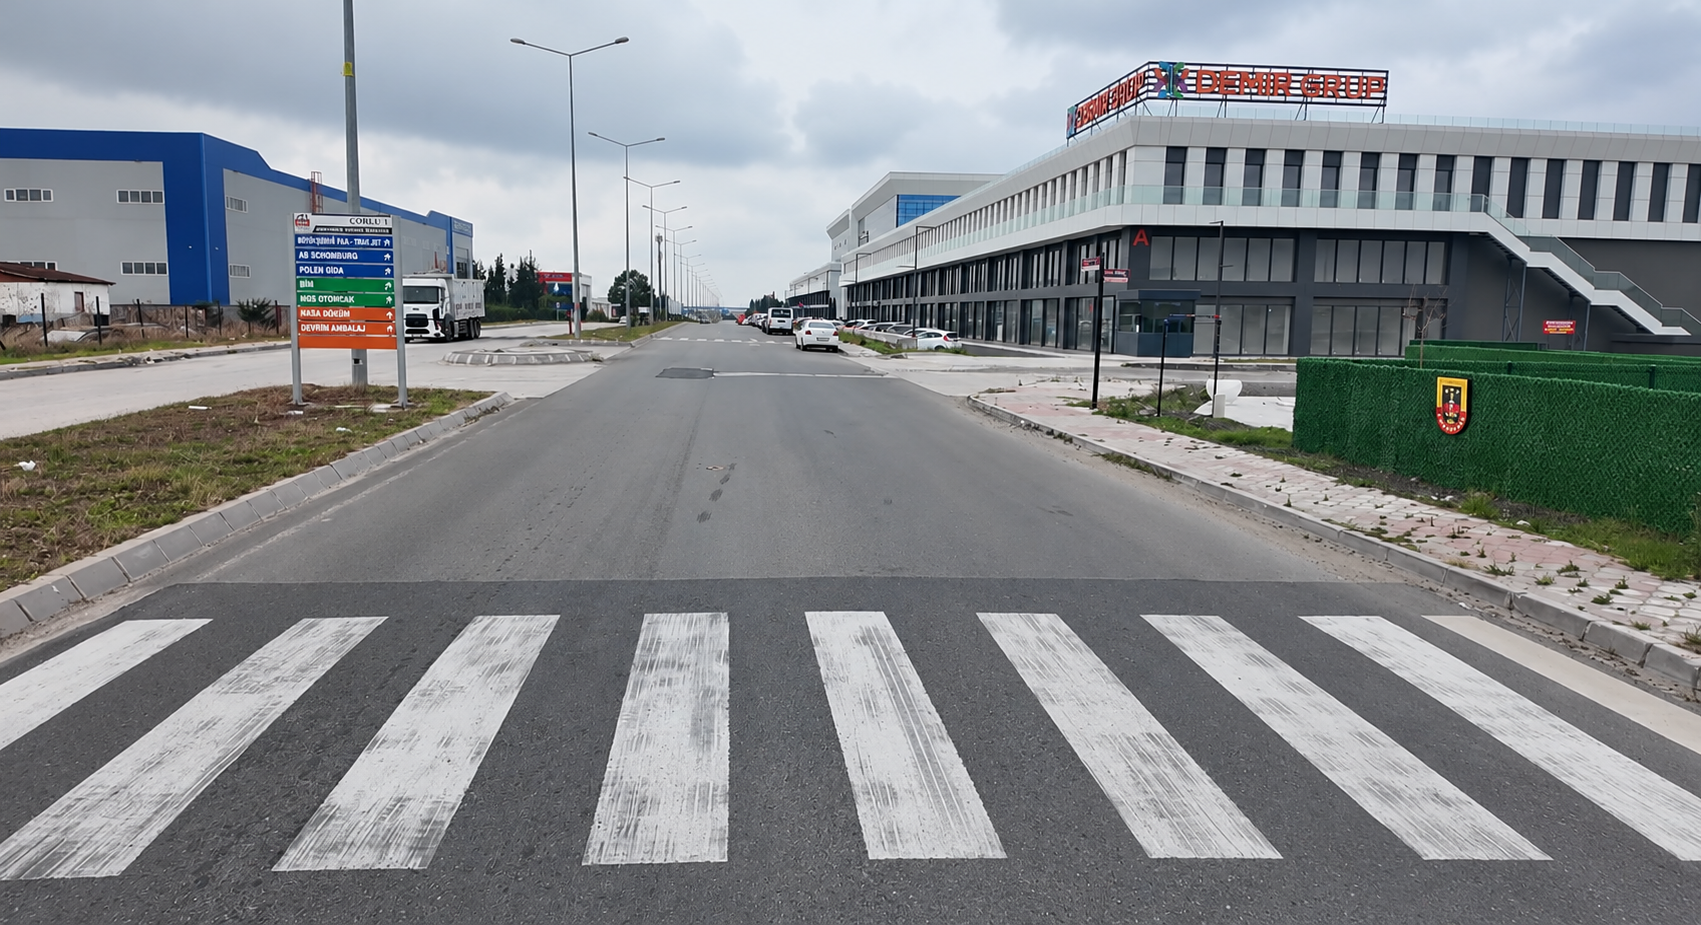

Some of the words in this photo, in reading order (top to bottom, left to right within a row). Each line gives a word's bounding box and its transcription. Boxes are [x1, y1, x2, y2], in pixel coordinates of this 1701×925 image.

[1196, 70, 1292, 96] DEMIR
[1300, 74, 1385, 99] GRUP
[1133, 228, 1149, 246] A
[299, 266, 324, 275] POLEN
[330, 323, 366, 333] AMBALAJ
